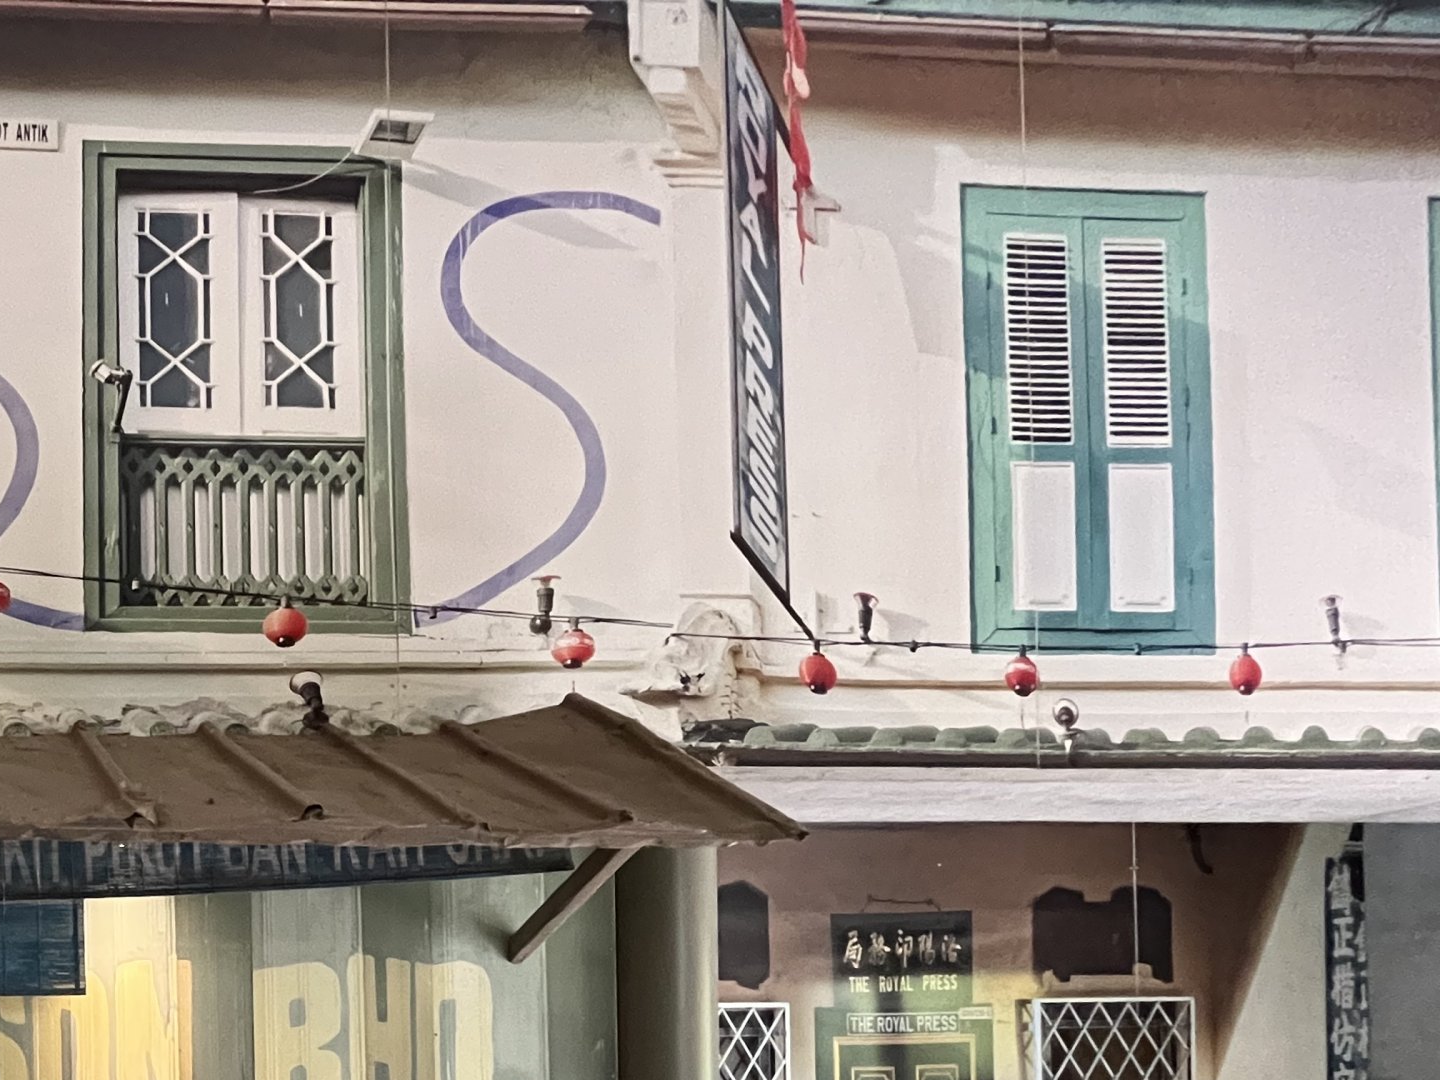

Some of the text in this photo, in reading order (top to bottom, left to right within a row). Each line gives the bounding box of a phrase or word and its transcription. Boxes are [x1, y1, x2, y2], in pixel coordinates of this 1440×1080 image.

[16, 123, 48, 143] ANTIK
[742, 301, 779, 563] PRESS
[848, 974, 958, 993] THE ROYAL PRESS
[850, 1015, 958, 1033] THE ROYAL PRESS
